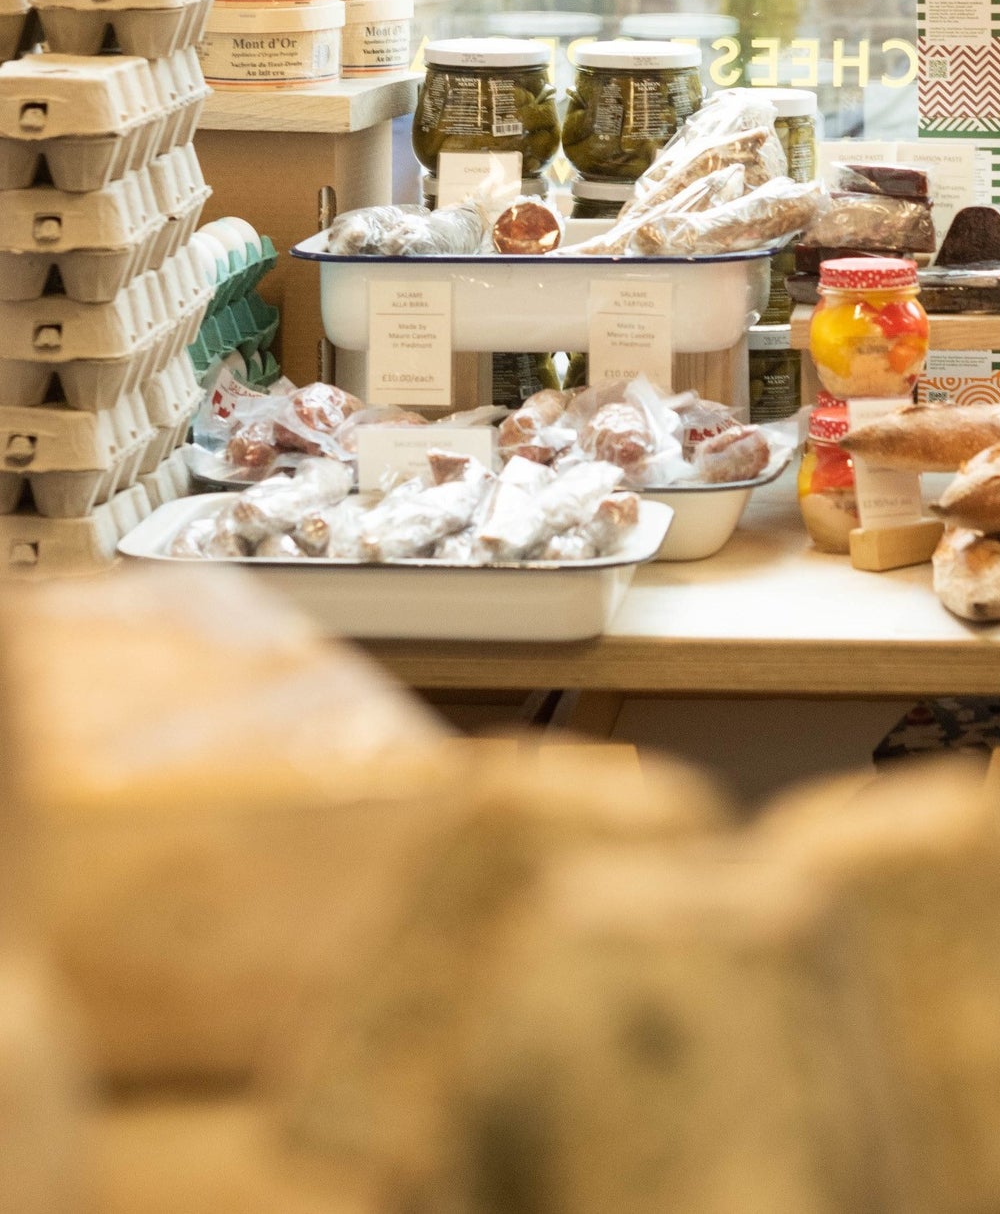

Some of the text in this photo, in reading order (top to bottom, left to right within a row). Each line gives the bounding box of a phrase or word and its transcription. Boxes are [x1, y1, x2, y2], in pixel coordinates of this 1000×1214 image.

[365, 26, 391, 37] Mont
[232, 38, 297, 49] Mont d'Or
[382, 374, 435, 383] £10.00/each
